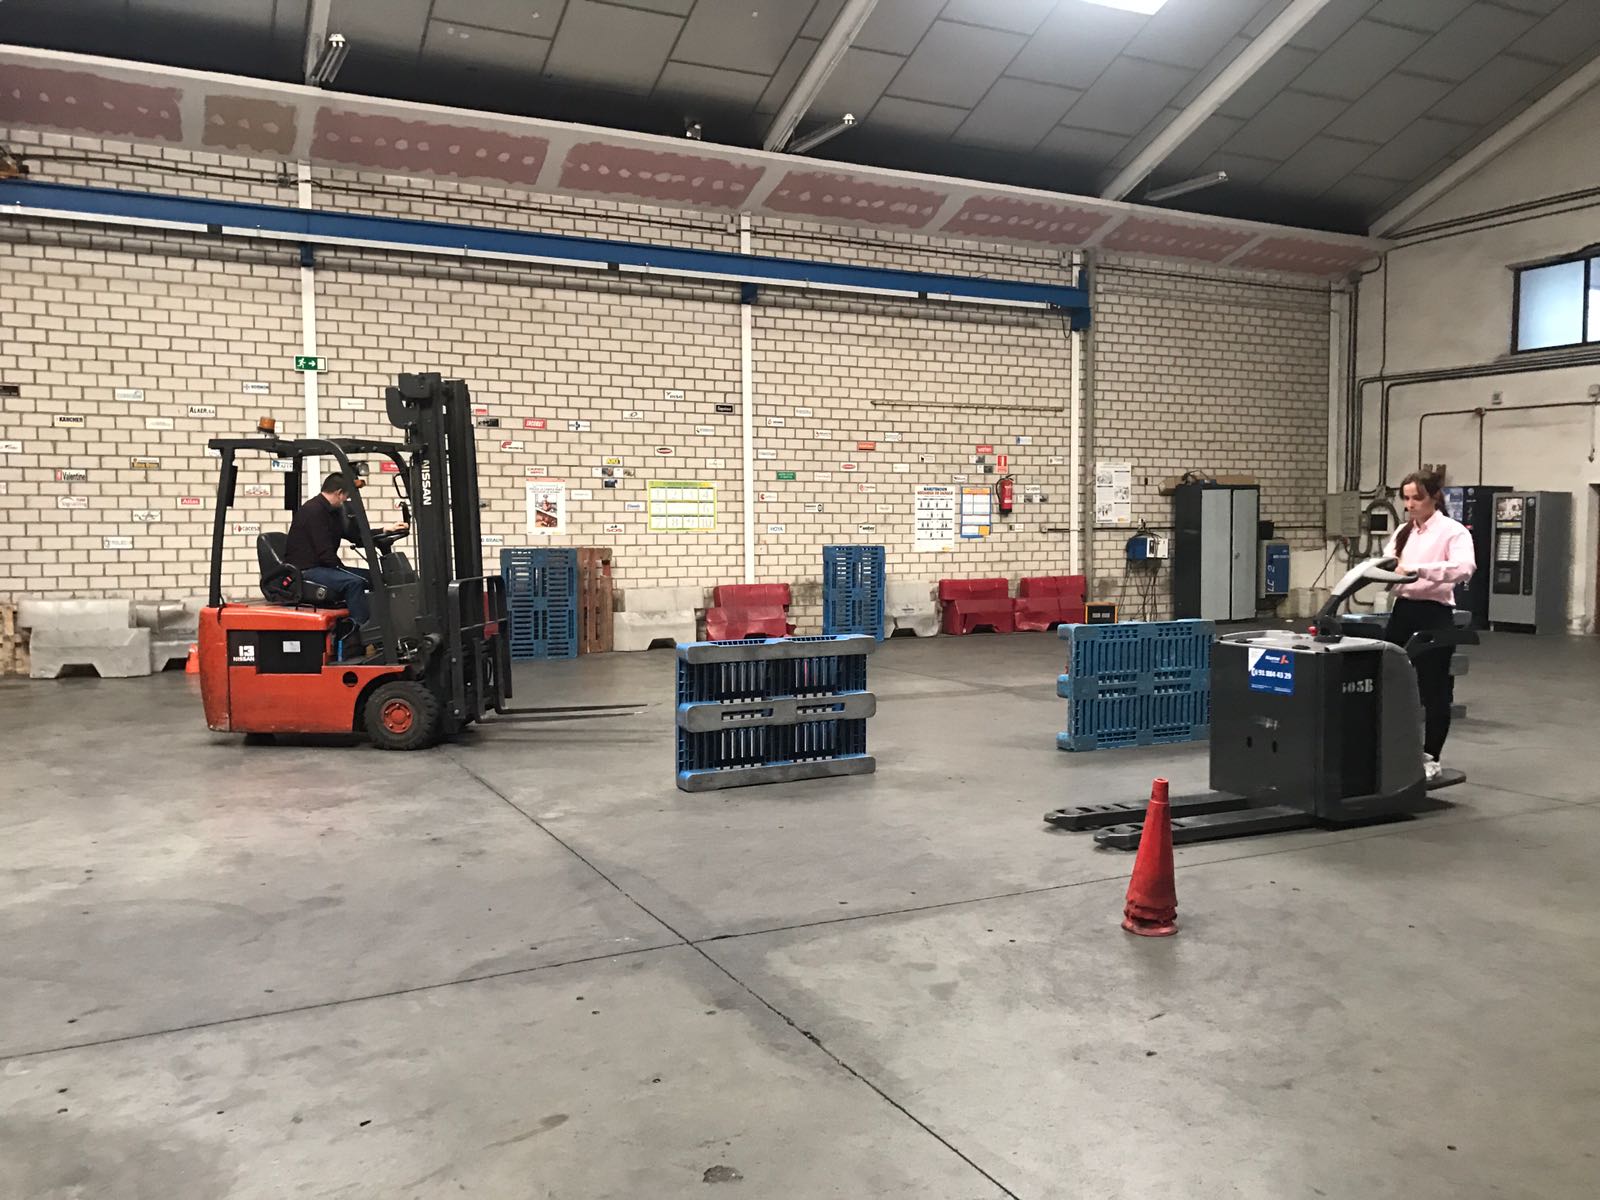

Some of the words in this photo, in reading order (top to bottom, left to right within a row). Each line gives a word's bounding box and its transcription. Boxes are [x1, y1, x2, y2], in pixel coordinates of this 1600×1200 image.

[63, 471, 86, 481] Valentine
[421, 459, 432, 506] NISSAN
[239, 645, 255, 657] 13
